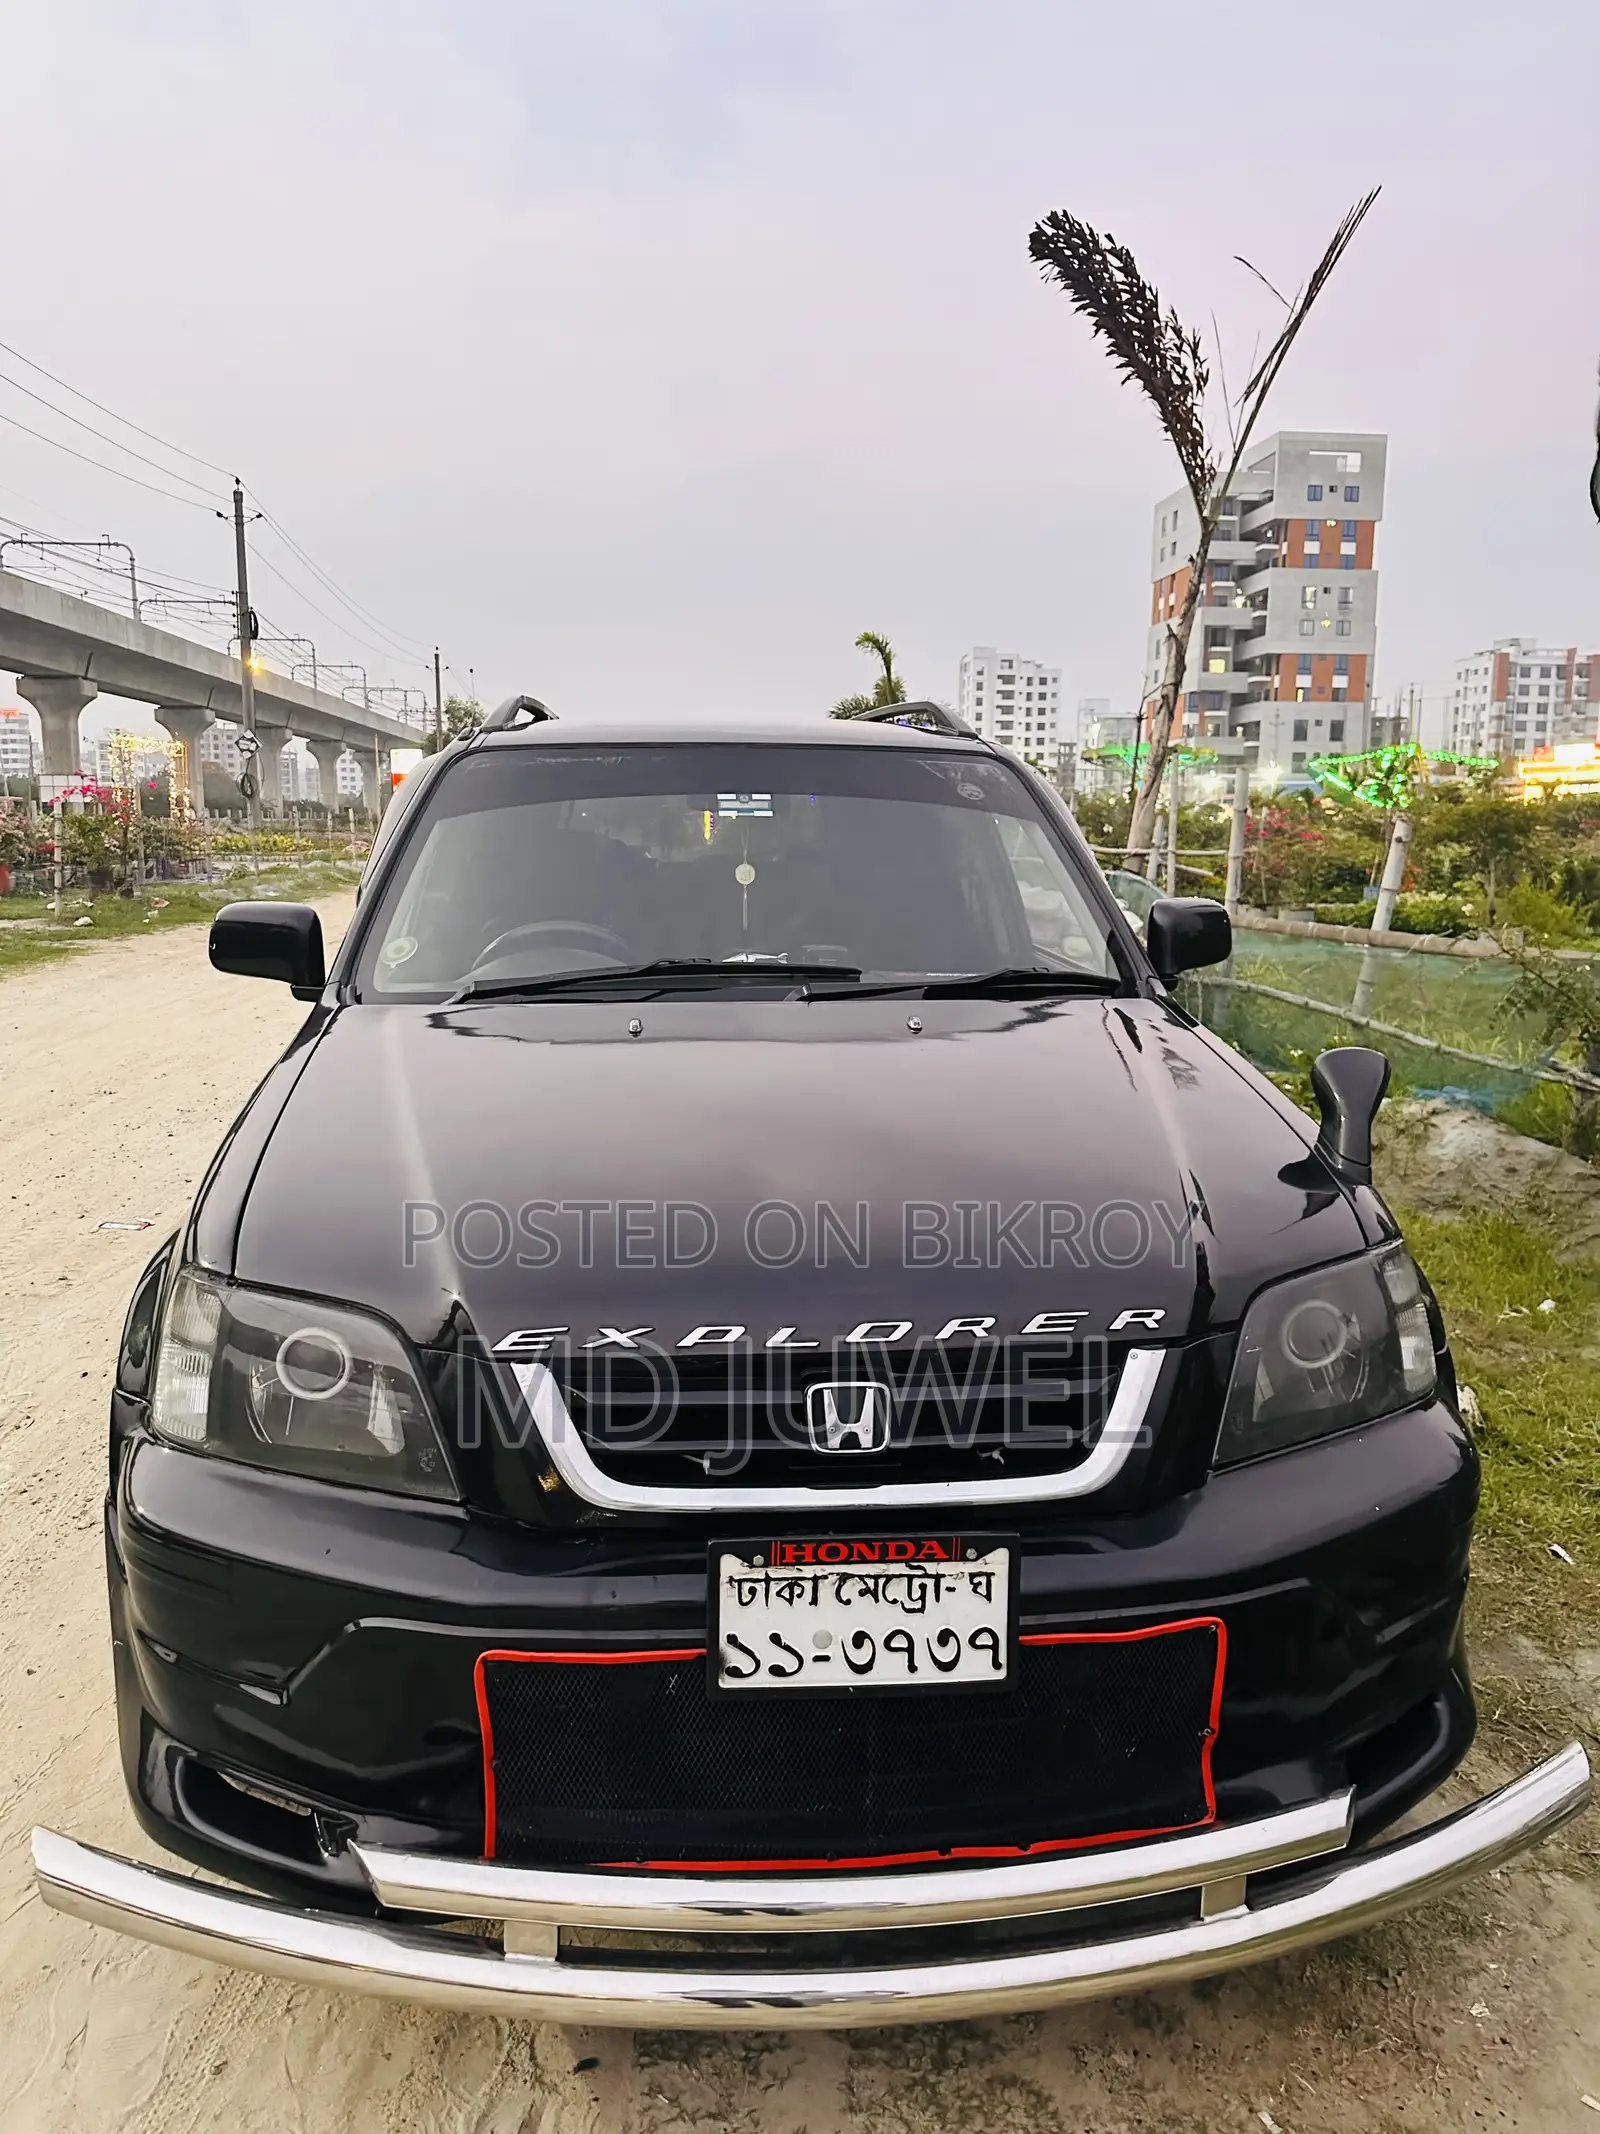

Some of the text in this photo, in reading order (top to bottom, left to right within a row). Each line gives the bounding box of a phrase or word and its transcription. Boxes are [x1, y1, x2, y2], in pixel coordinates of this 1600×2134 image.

[491, 1308, 1167, 1352] EXPLORER
[782, 1540, 949, 1564] HONDA
[728, 1571, 828, 1607] ঢাকা
[725, 1626, 1003, 1679] ১১-৩৭৩৭
